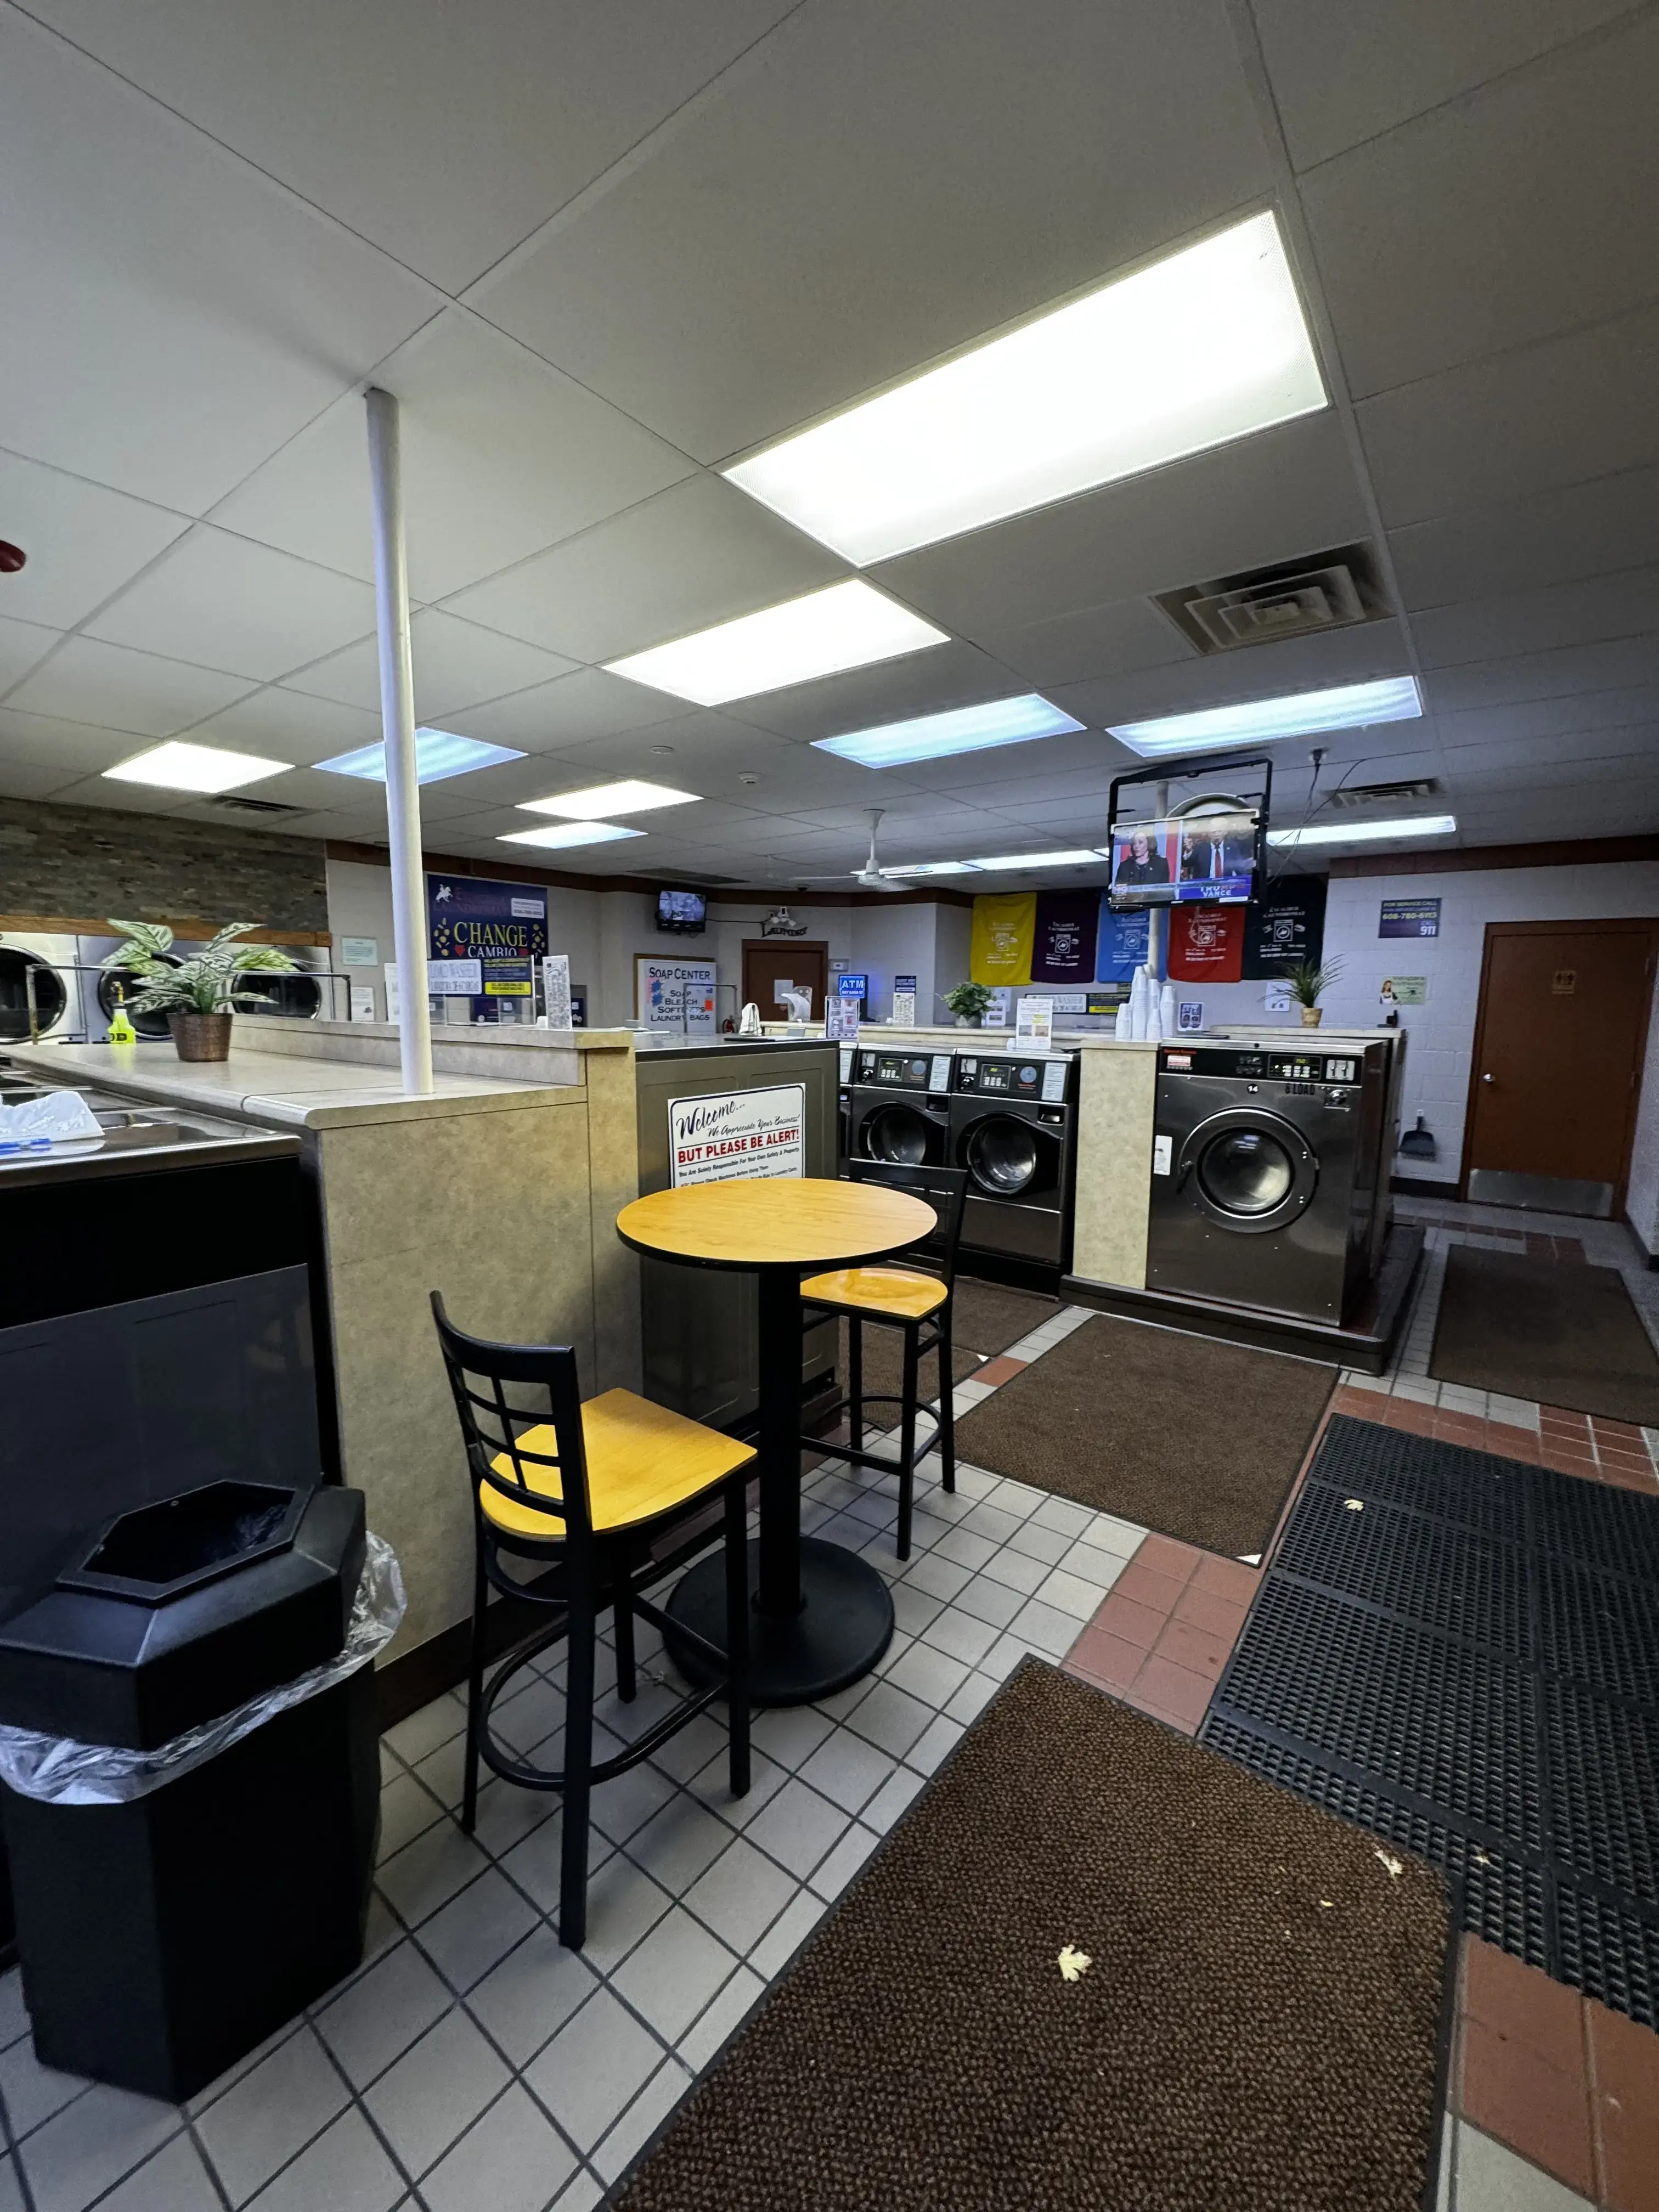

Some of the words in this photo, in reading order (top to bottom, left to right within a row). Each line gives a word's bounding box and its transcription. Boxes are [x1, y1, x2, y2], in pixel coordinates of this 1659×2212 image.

[454, 922, 528, 947] CHANGE
[1419, 926, 1436, 935] 911
[467, 945, 517, 957] CAMBIO
[649, 967, 673, 979] SOAP
[674, 968, 711, 980] CENTER
[842, 980, 864, 989] ATM
[1293, 1084, 1316, 1096] LOAD
[708, 1127, 720, 1137] We
[721, 1122, 756, 1137] Appreciate
[757, 1118, 773, 1131] Your
[678, 1147, 703, 1164] BUT
[706, 1138, 748, 1158] PLEASE
[751, 1135, 764, 1149] BE
[766, 1128, 800, 1145] ALERT!
[697, 1166, 712, 1175] Solely
[713, 1160, 739, 1170] Responsible
[783, 1147, 799, 1155] Property
